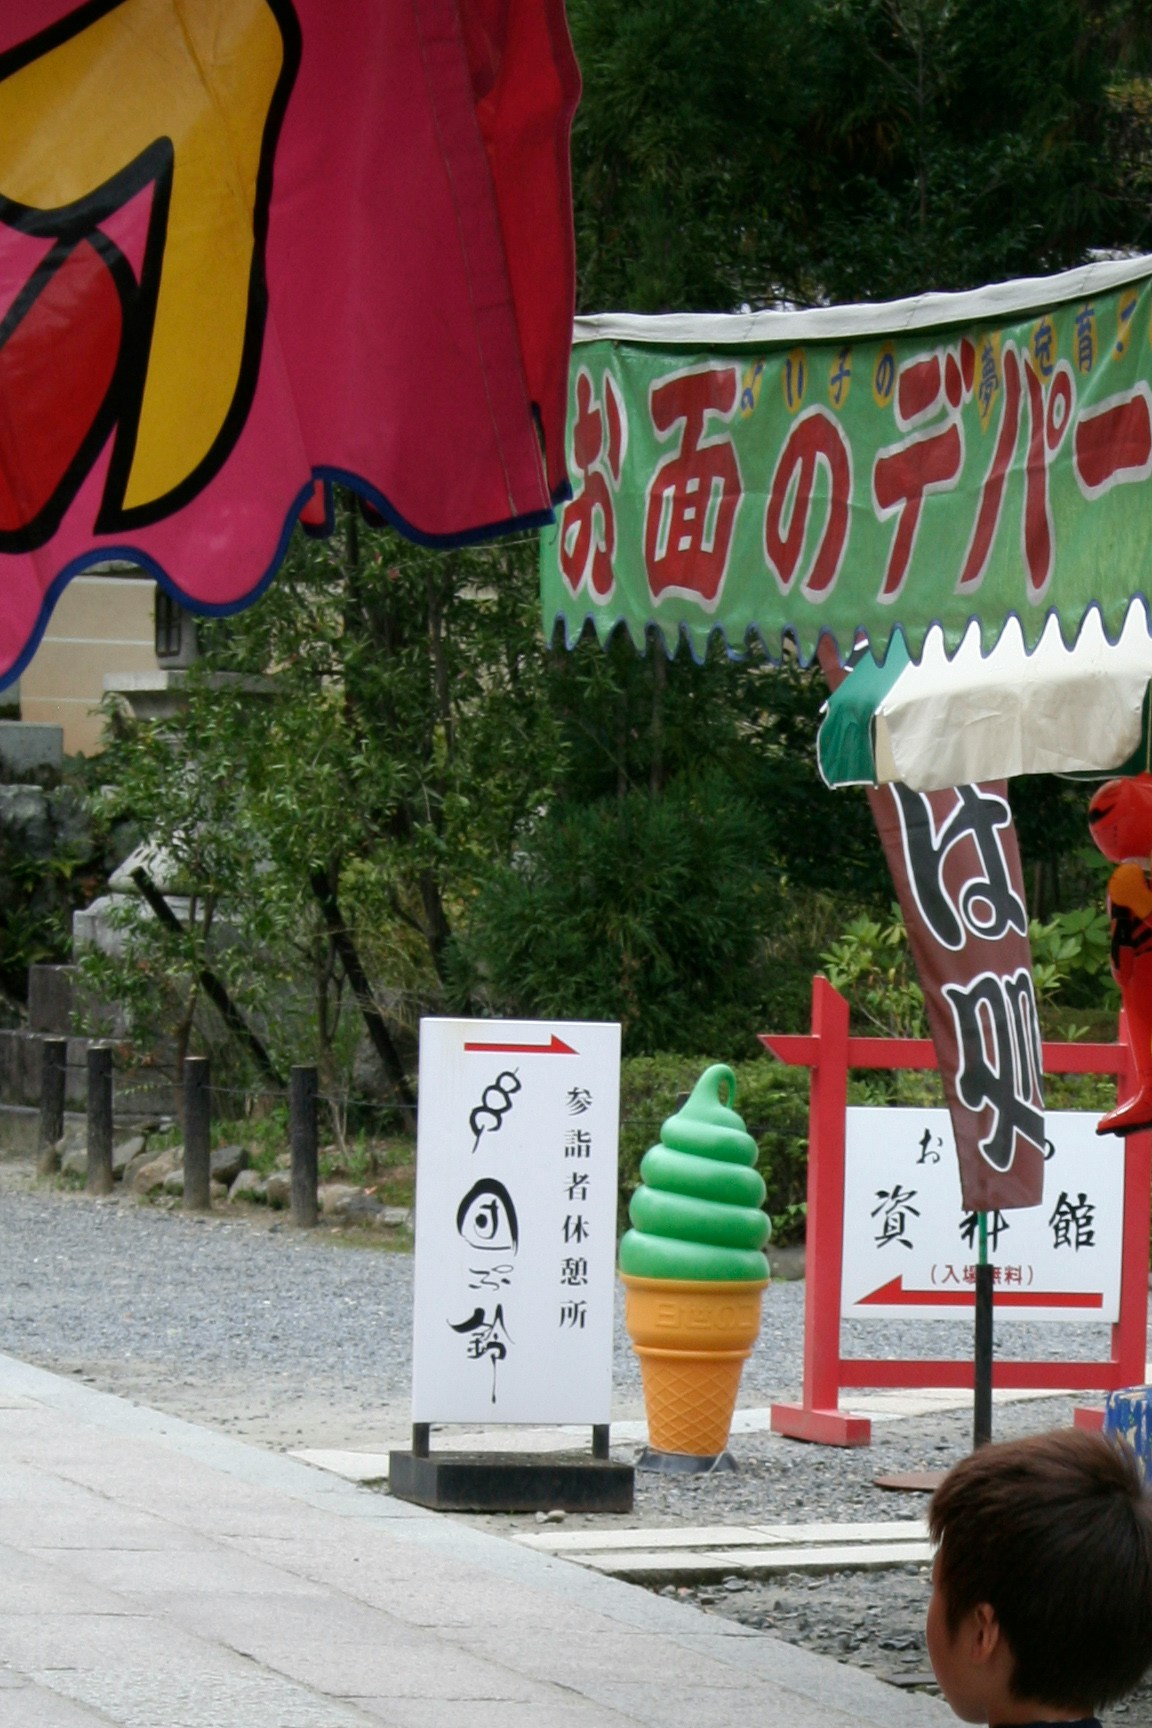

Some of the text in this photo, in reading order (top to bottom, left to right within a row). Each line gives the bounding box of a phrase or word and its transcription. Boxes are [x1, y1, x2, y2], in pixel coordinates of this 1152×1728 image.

[558, 1086, 593, 1330] 参詣者休憩所
[870, 1184, 1097, 1253] 資料館
